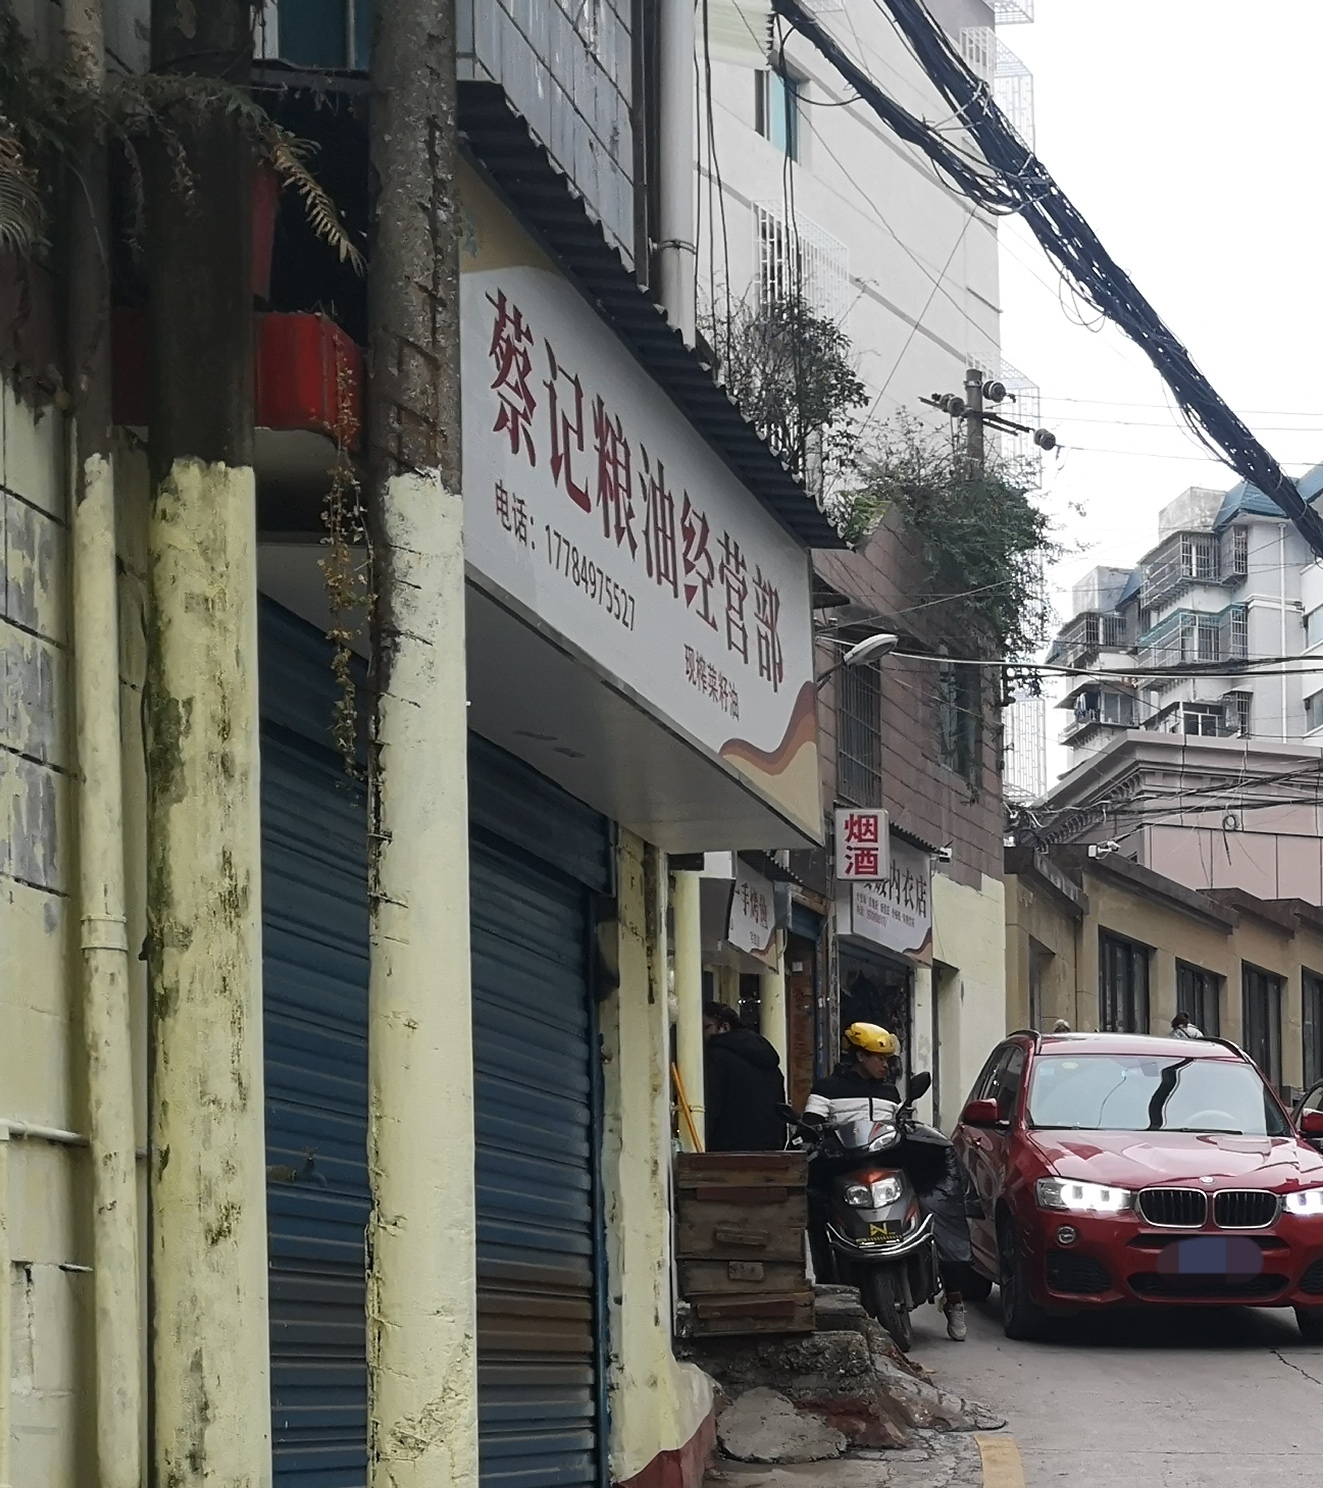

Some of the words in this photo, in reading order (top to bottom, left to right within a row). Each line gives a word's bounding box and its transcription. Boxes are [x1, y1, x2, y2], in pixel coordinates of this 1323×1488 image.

[485, 287, 784, 694] 蔡记粮油经营部
[844, 813, 879, 876] 烟酒
